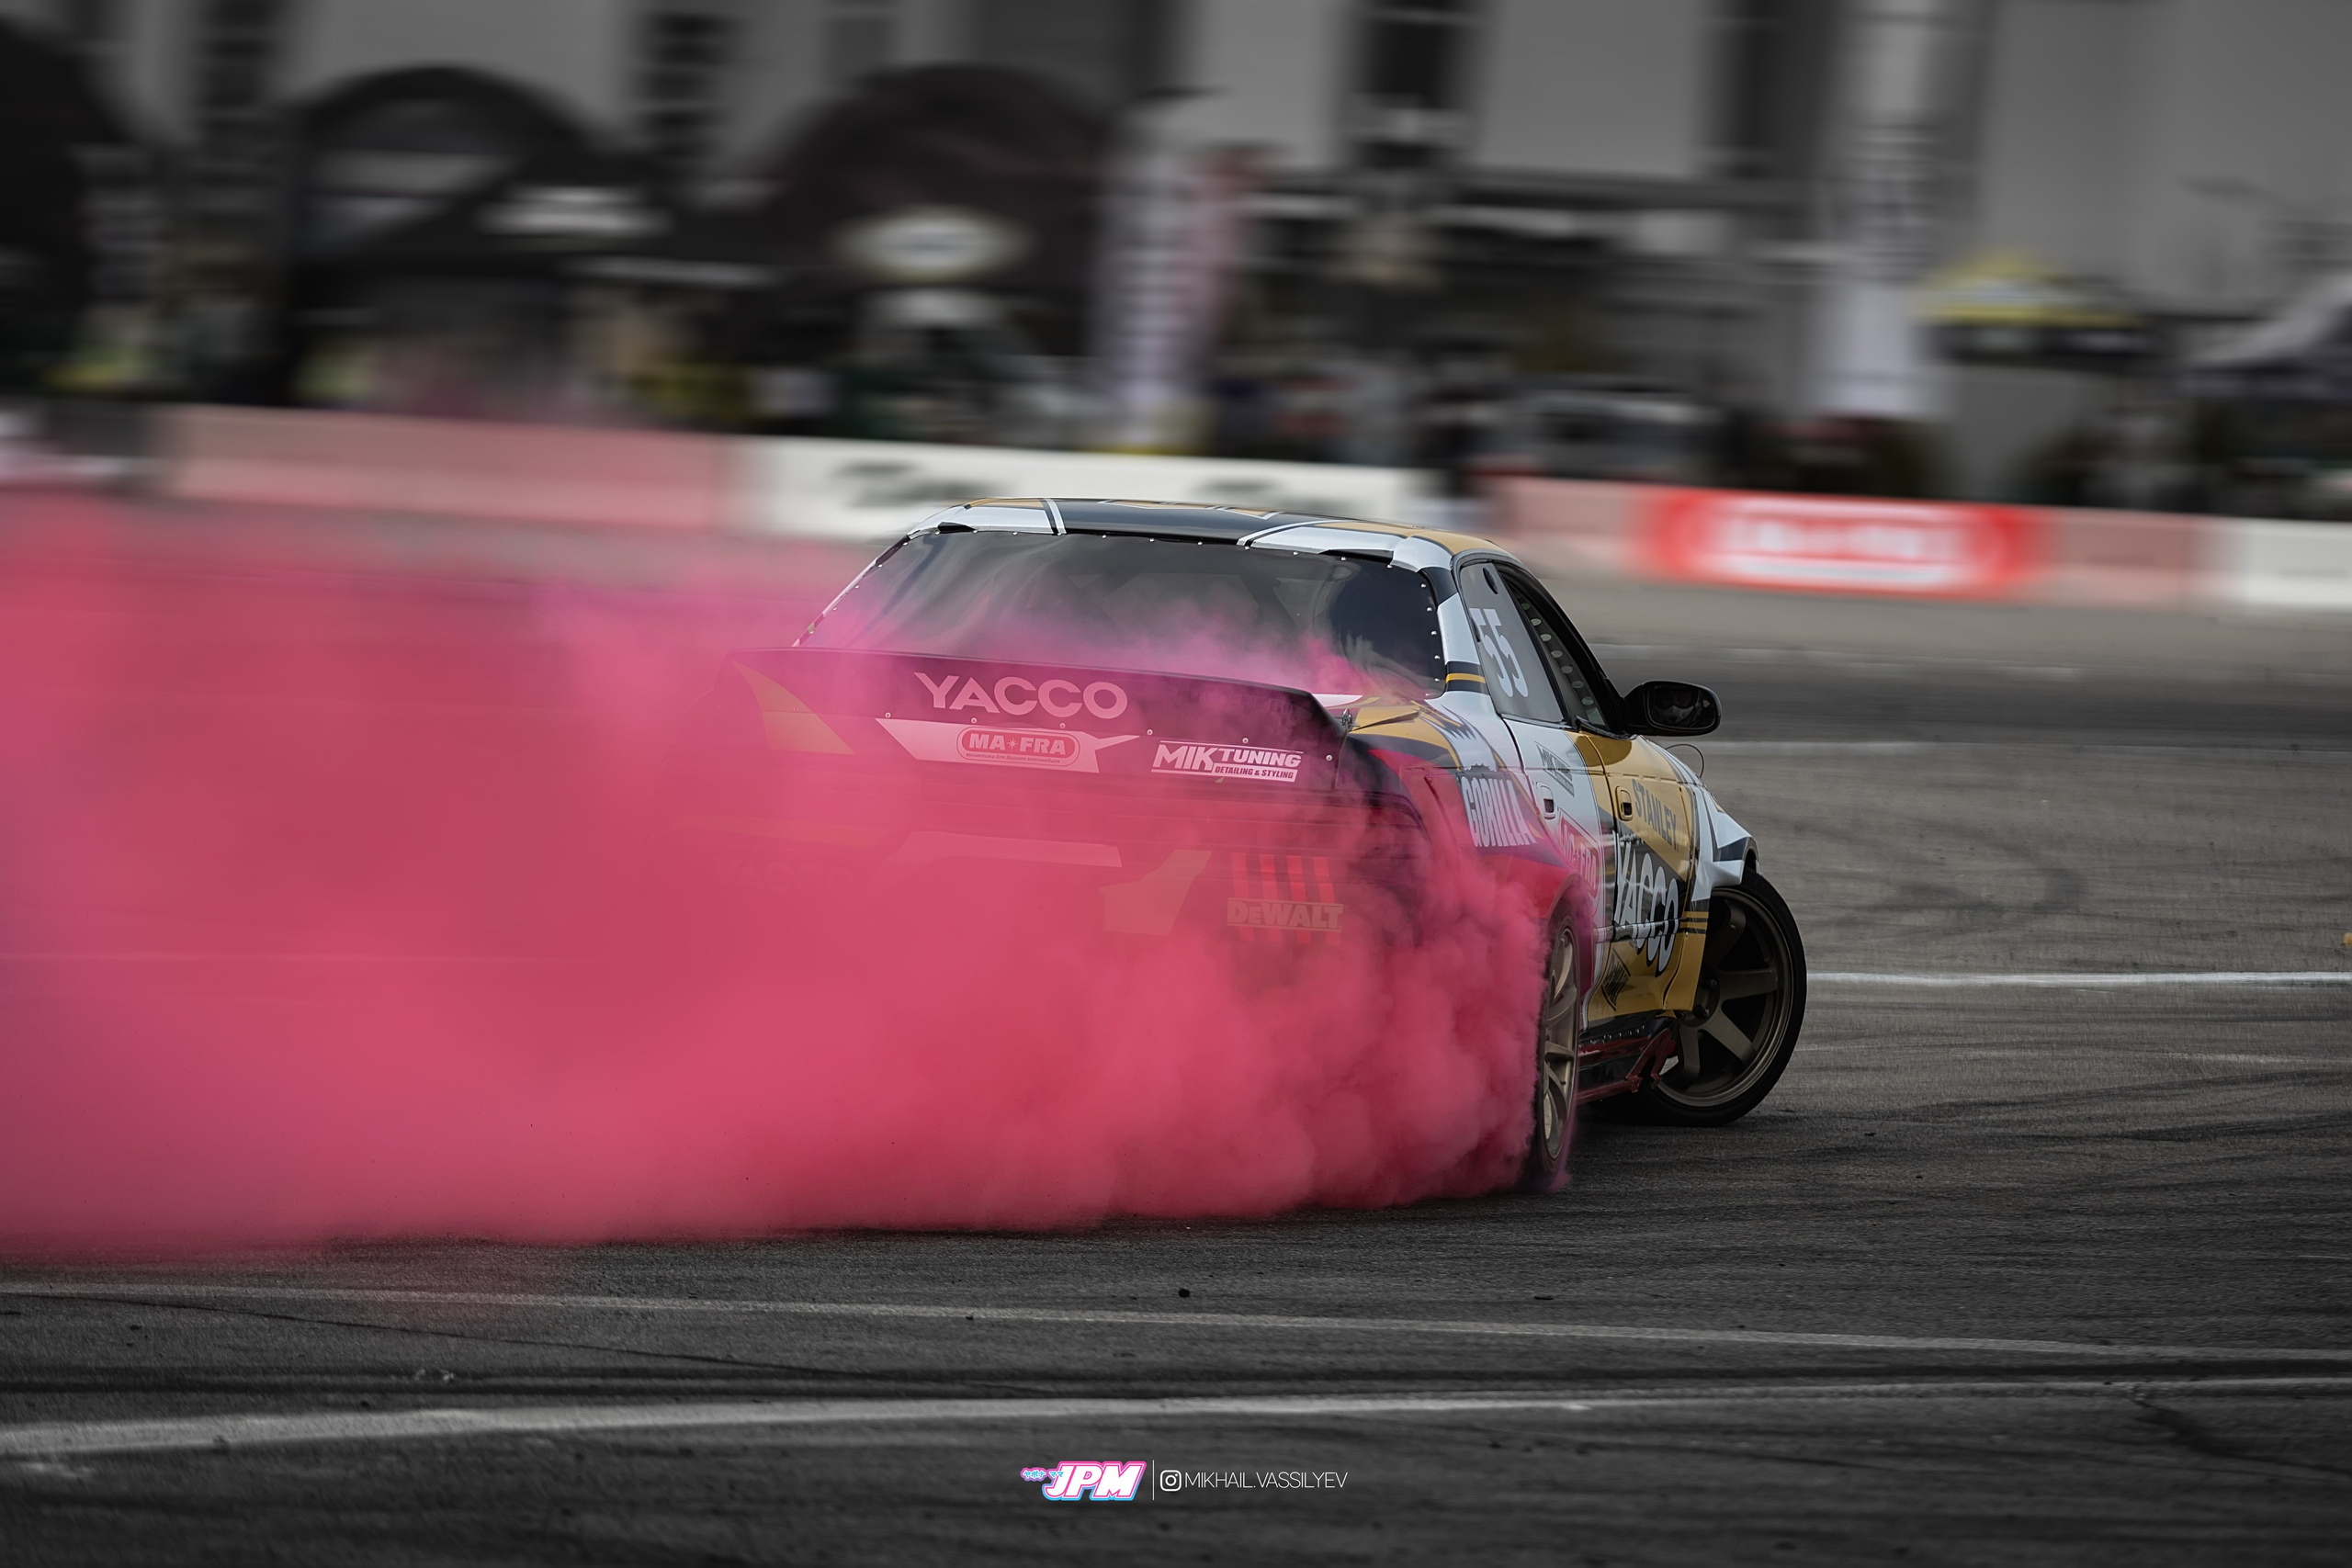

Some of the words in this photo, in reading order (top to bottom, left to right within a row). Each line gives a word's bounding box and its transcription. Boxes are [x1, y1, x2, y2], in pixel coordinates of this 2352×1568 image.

[1468, 607, 1529, 697] 55
[913, 672, 1127, 719] YACCO
[1215, 765, 1253, 775] DETAILING
[1261, 769, 1294, 779] STYLING
[1461, 776, 1537, 847] GORILLA
[1632, 778, 1677, 851] STANLEY
[1612, 829, 1679, 972] YACCO
